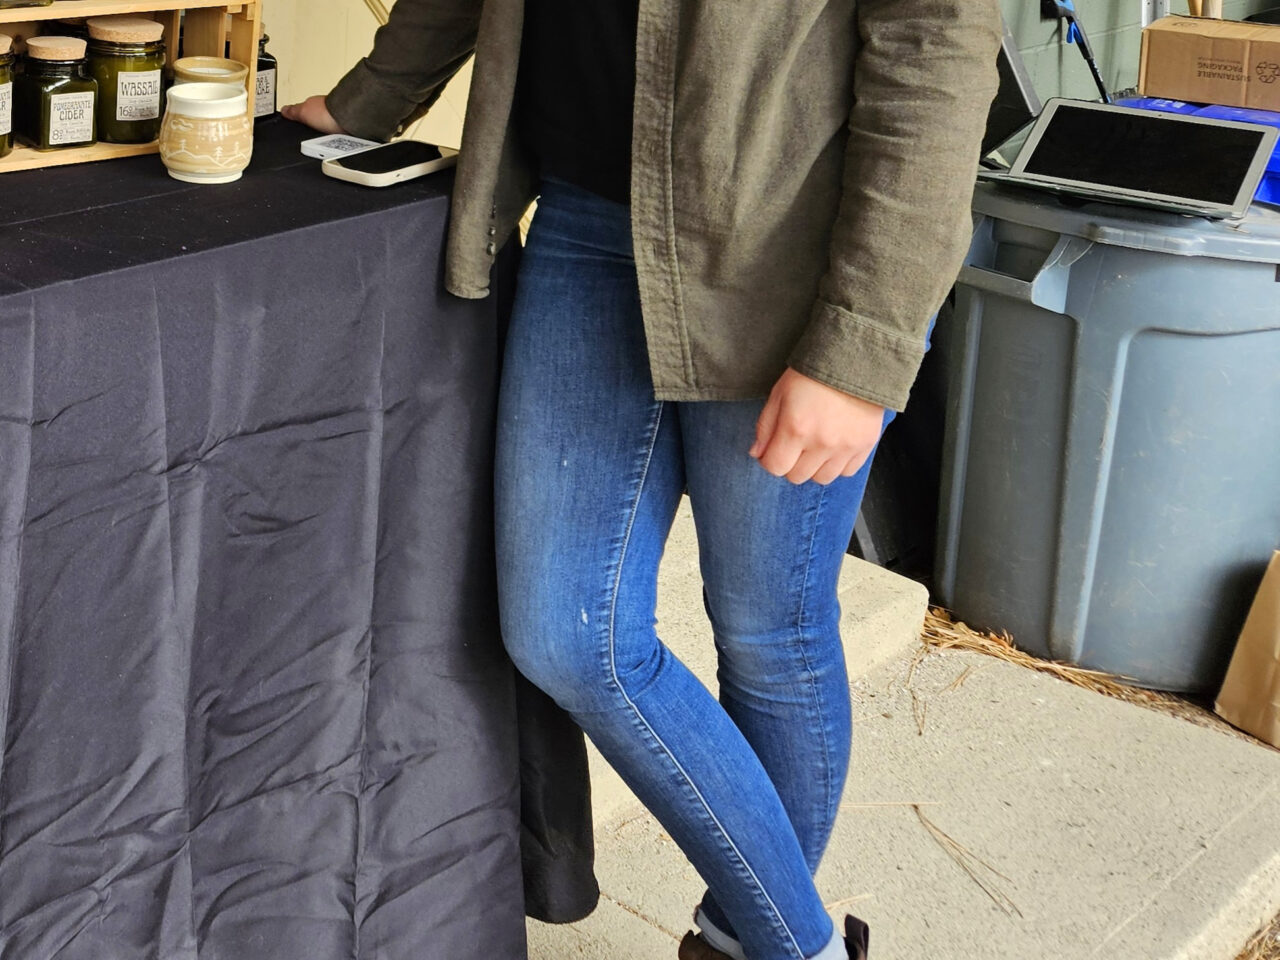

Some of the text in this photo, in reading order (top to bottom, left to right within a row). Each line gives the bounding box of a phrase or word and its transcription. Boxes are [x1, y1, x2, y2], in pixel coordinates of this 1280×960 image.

[1198, 62, 1242, 72] PACKAGING
[1198, 70, 1251, 82] SUSTAINABLE
[121, 80, 158, 97] WASSAIL
[59, 109, 84, 121] CIDER
